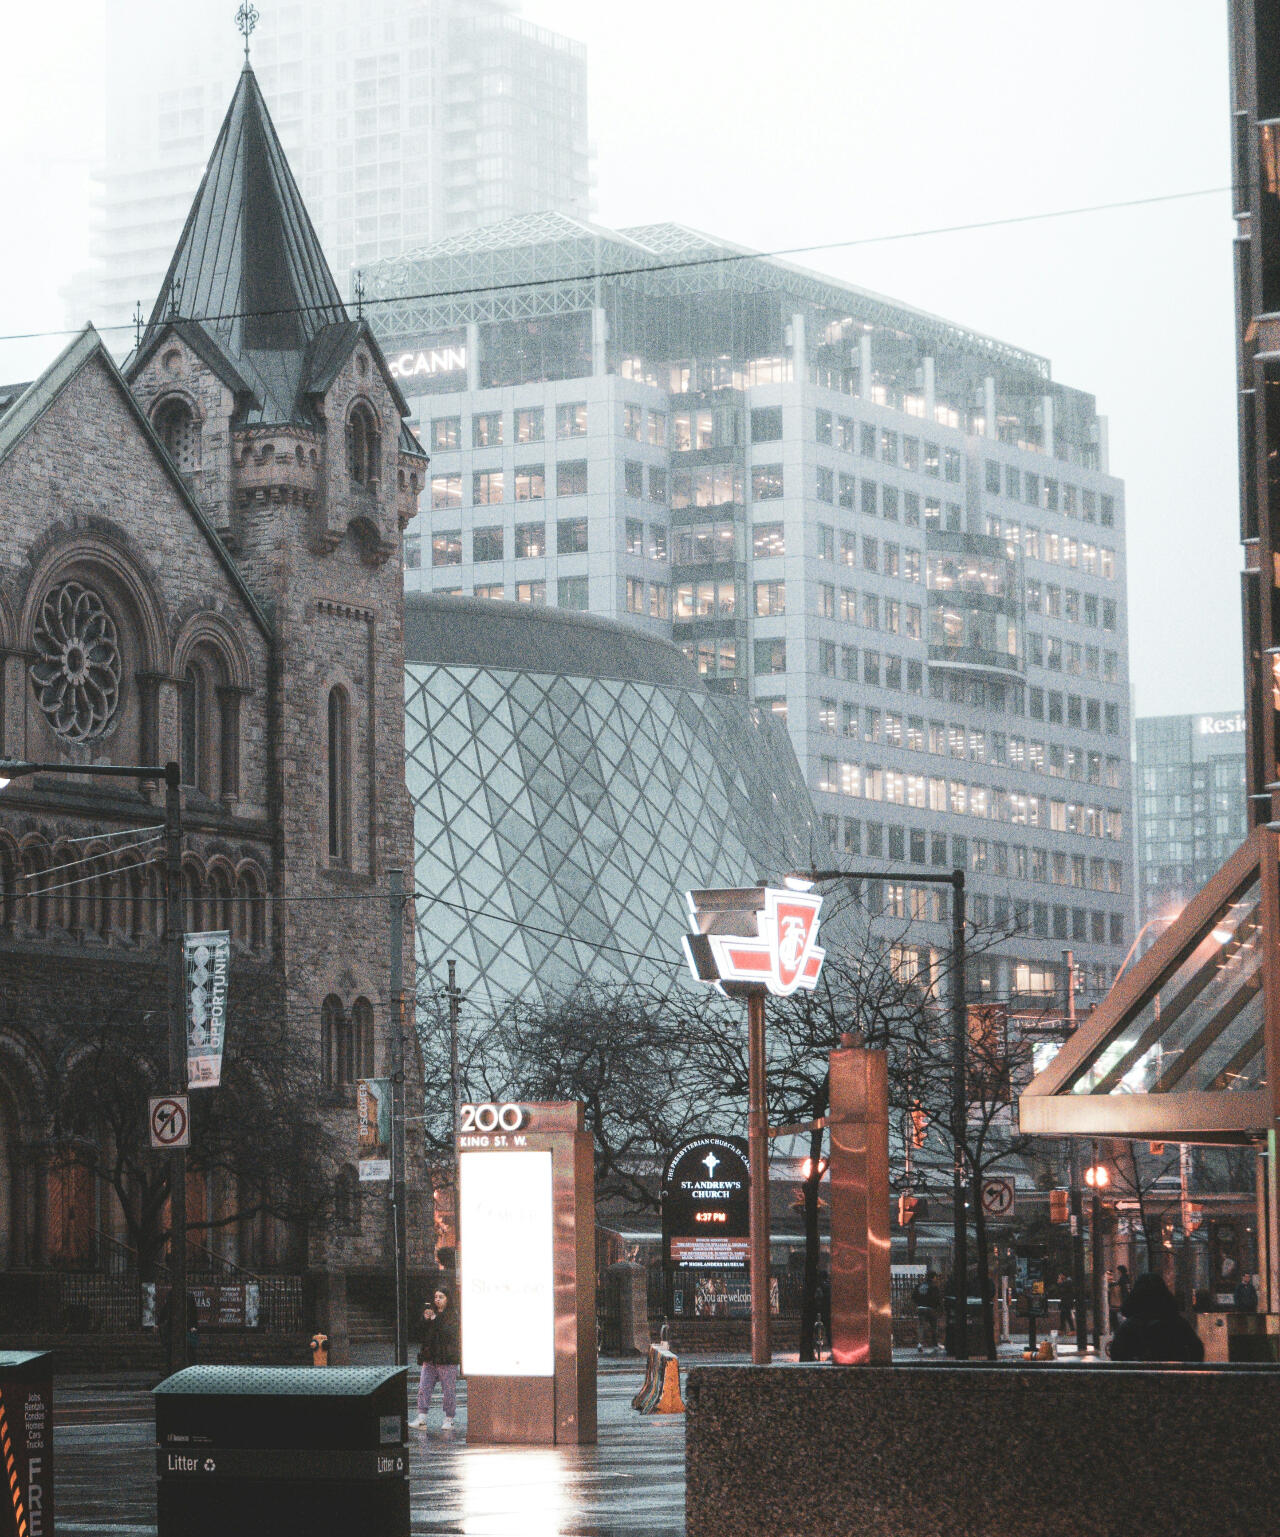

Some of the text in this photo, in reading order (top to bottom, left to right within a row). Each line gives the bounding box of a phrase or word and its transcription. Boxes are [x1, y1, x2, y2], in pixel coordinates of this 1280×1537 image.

[211, 937, 228, 1049] OPPORTUNITY
[359, 1084, 369, 1136] DISCOVER
[461, 1104, 522, 1131] 200
[460, 1136, 527, 1147] KING ST. W.
[681, 1181, 741, 1189] ST. ANDREW'S
[692, 1190, 730, 1198] CHURCH
[695, 1212, 726, 1222] 4:37 PM
[701, 1289, 715, 1302] You
[717, 1294, 728, 1302] are
[28, 1393, 41, 1402] Jobs
[24, 1402, 45, 1411] Rentals
[24, 1412, 45, 1420] Condos
[25, 1421, 45, 1430] Homes
[29, 1430, 41, 1439] Cars
[168, 1454, 198, 1470] Litter
[377, 1457, 394, 1473] Litter
